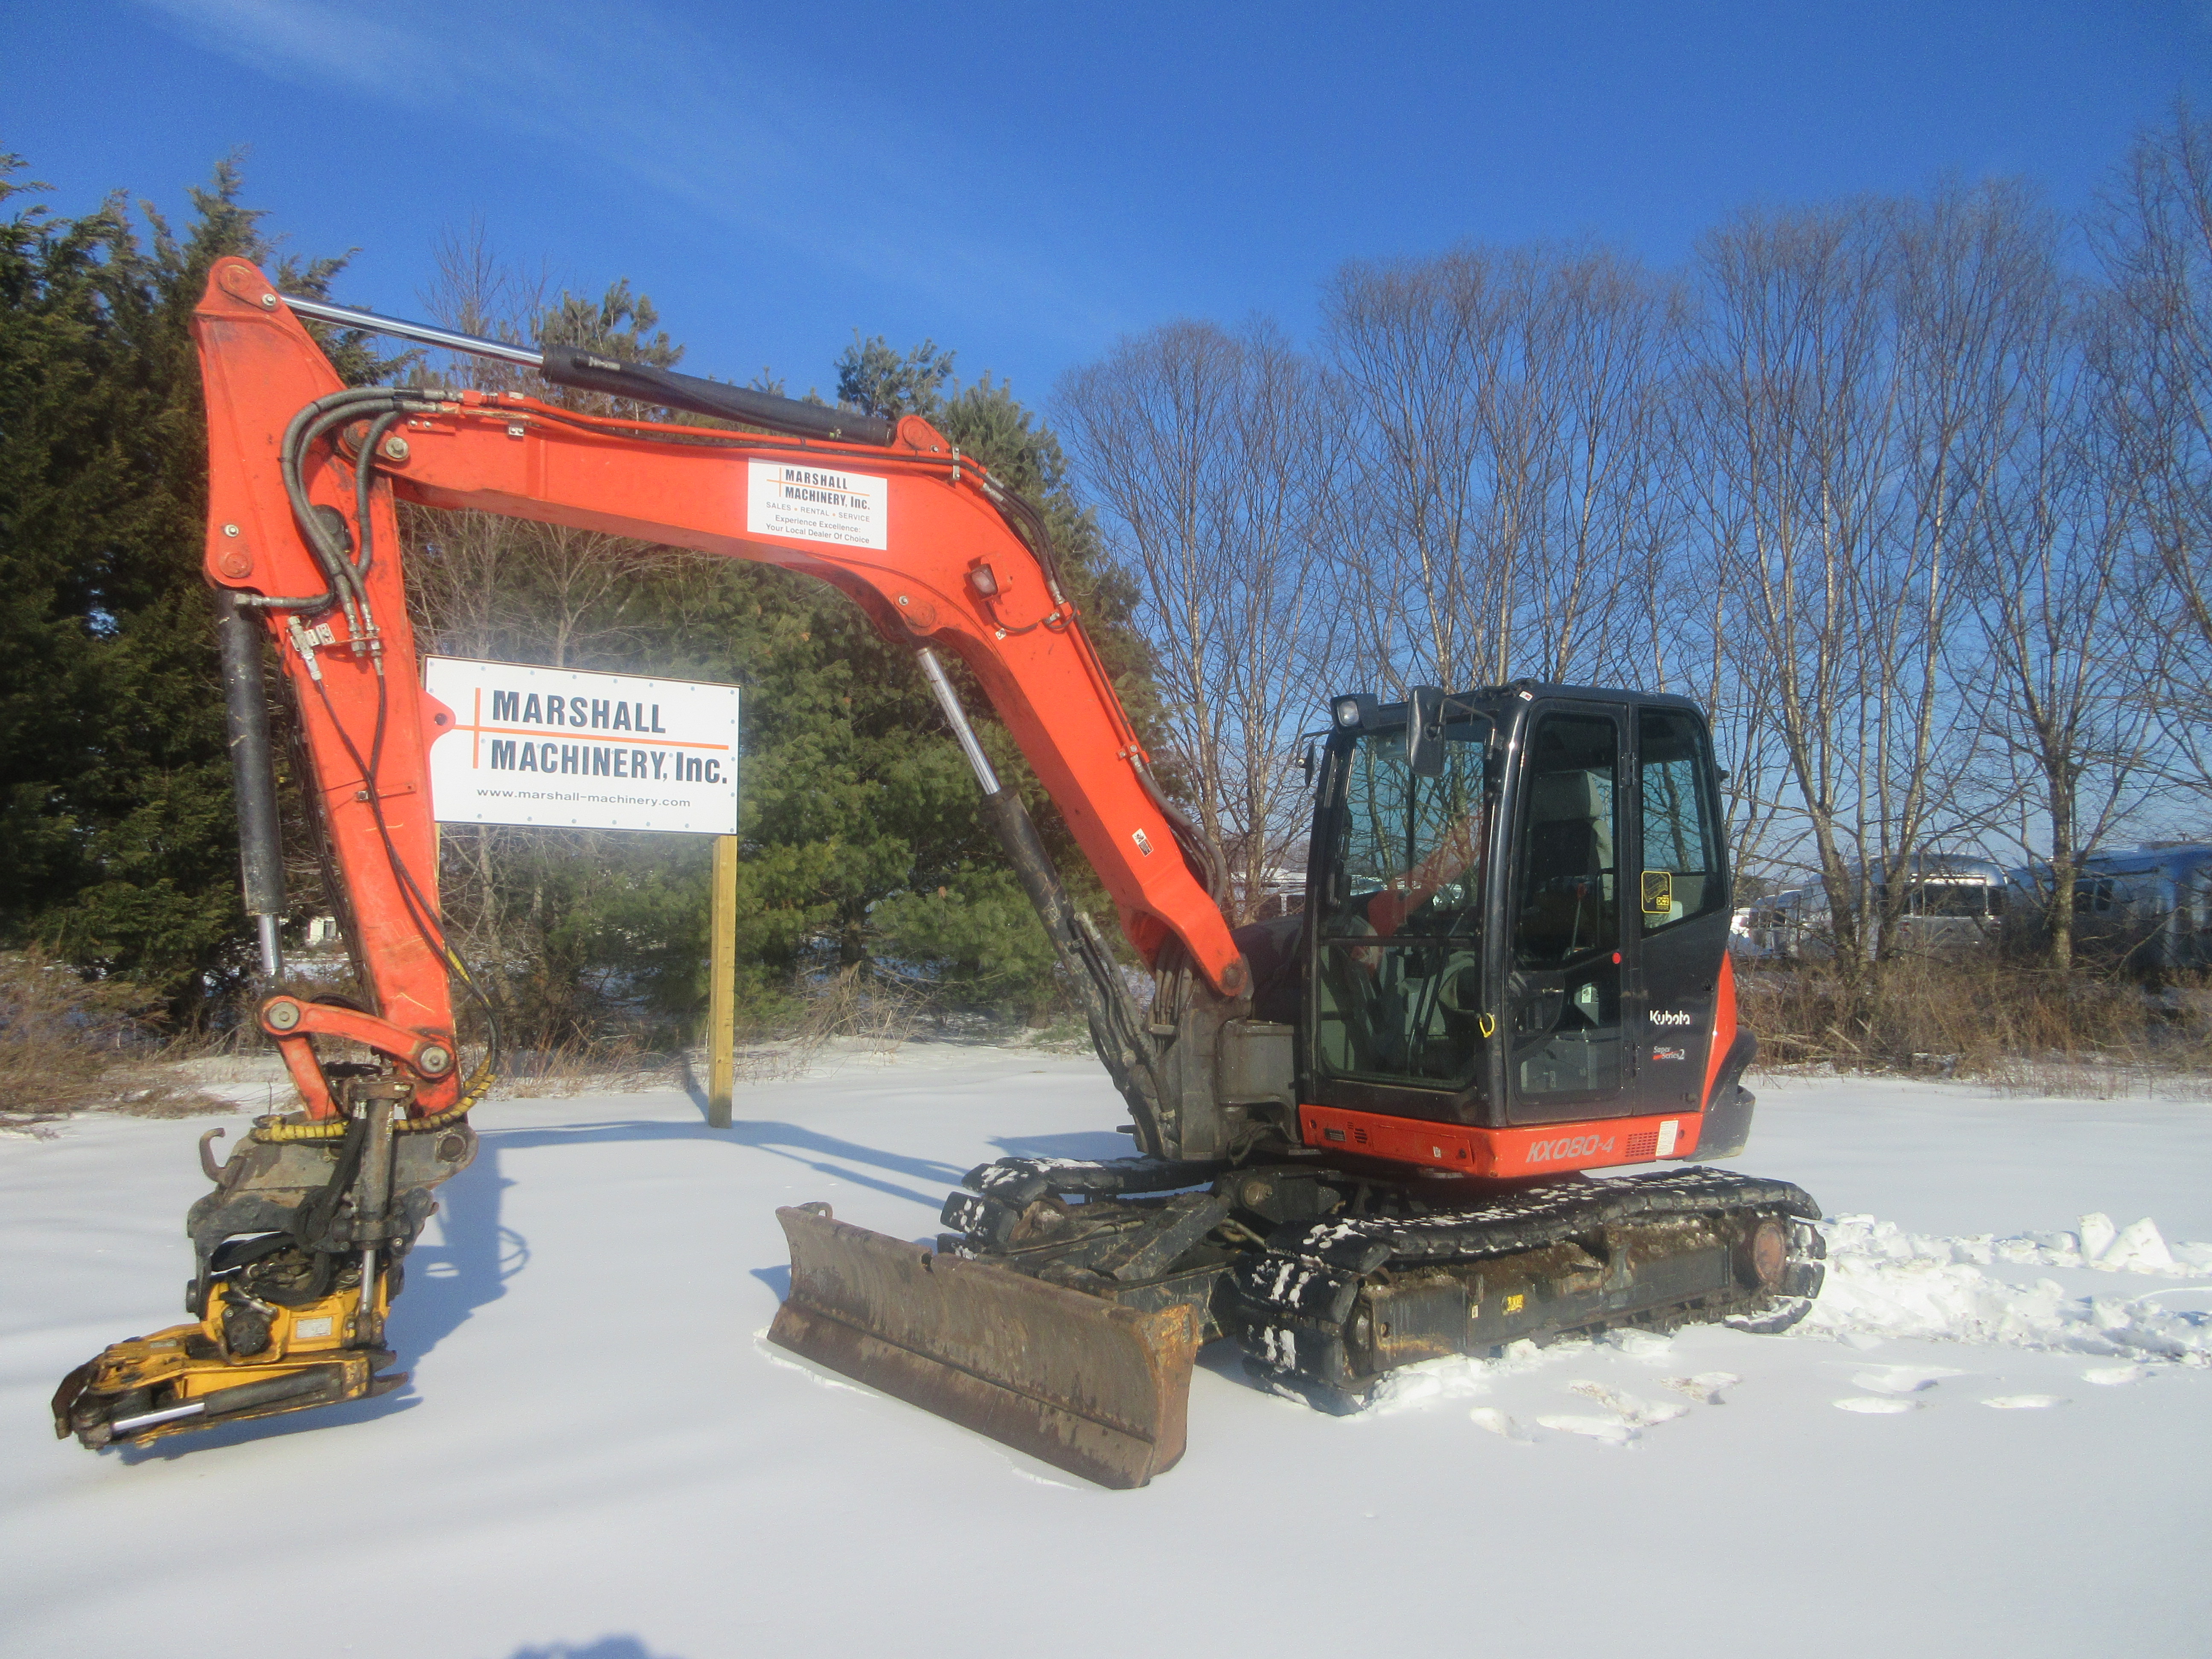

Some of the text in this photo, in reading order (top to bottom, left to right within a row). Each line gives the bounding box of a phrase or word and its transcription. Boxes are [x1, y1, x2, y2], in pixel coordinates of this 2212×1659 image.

[786, 469, 847, 489] MARSHALL
[785, 486, 870, 510] MACHINERY, Inc.
[766, 501, 870, 522] SALES RENTAL SERVICE
[766, 523, 784, 532] Your
[786, 526, 806, 535] Local
[808, 530, 831, 538] Dealer
[844, 534, 870, 544] Choice
[775, 515, 861, 533] Experience Excellence:
[493, 690, 666, 733] MARSHALL
[491, 739, 728, 784] MACHINERY, Inc.
[477, 789, 691, 807] www.marshall-machinery.com
[1650, 1010, 1690, 1025] Kubota
[1653, 1046, 1671, 1054] Super
[1525, 1134, 1616, 1163] KX080-4
